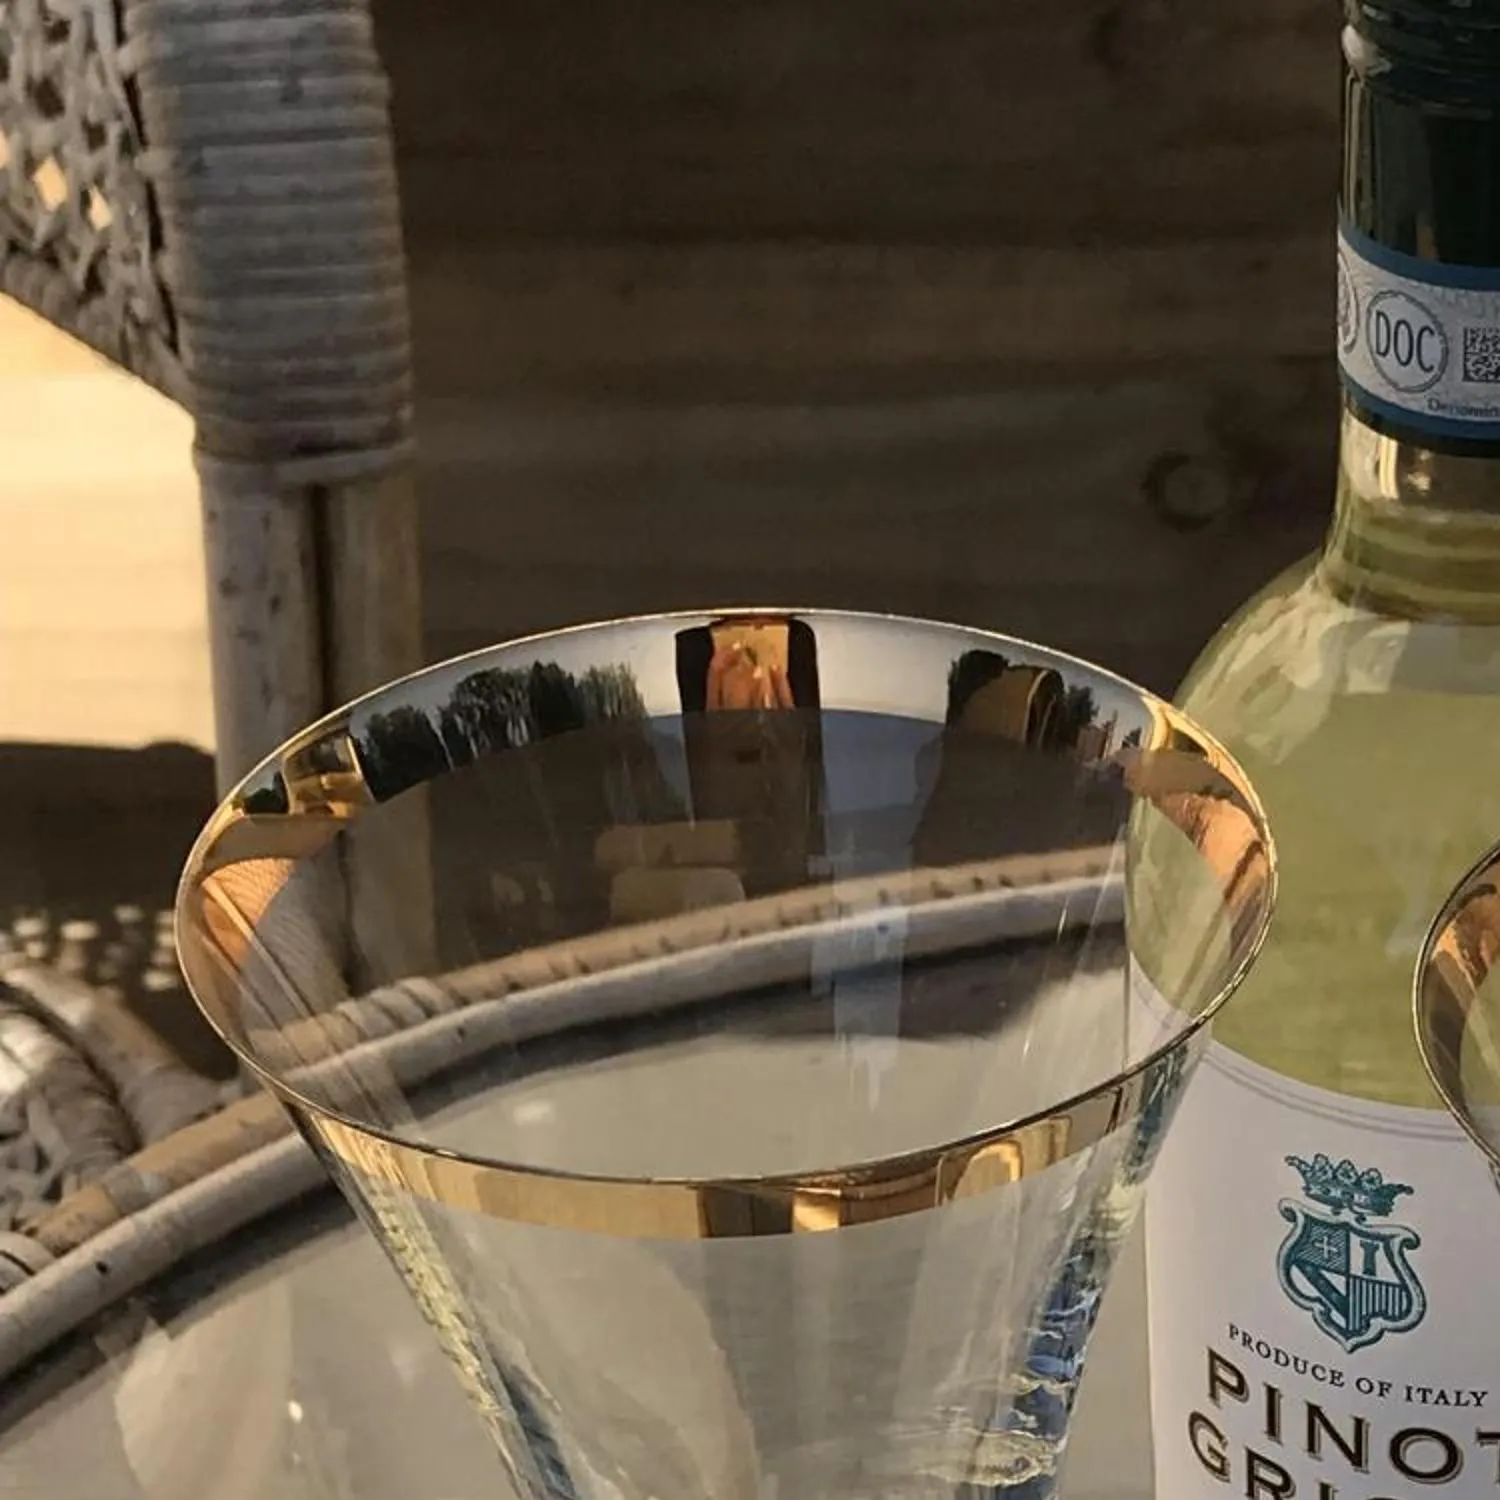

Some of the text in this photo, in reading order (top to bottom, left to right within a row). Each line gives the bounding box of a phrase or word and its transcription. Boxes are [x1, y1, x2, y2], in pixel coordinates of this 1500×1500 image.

[1374, 311, 1434, 373] DOC
[1228, 1322, 1488, 1409] PRODUCE OF ITALY
